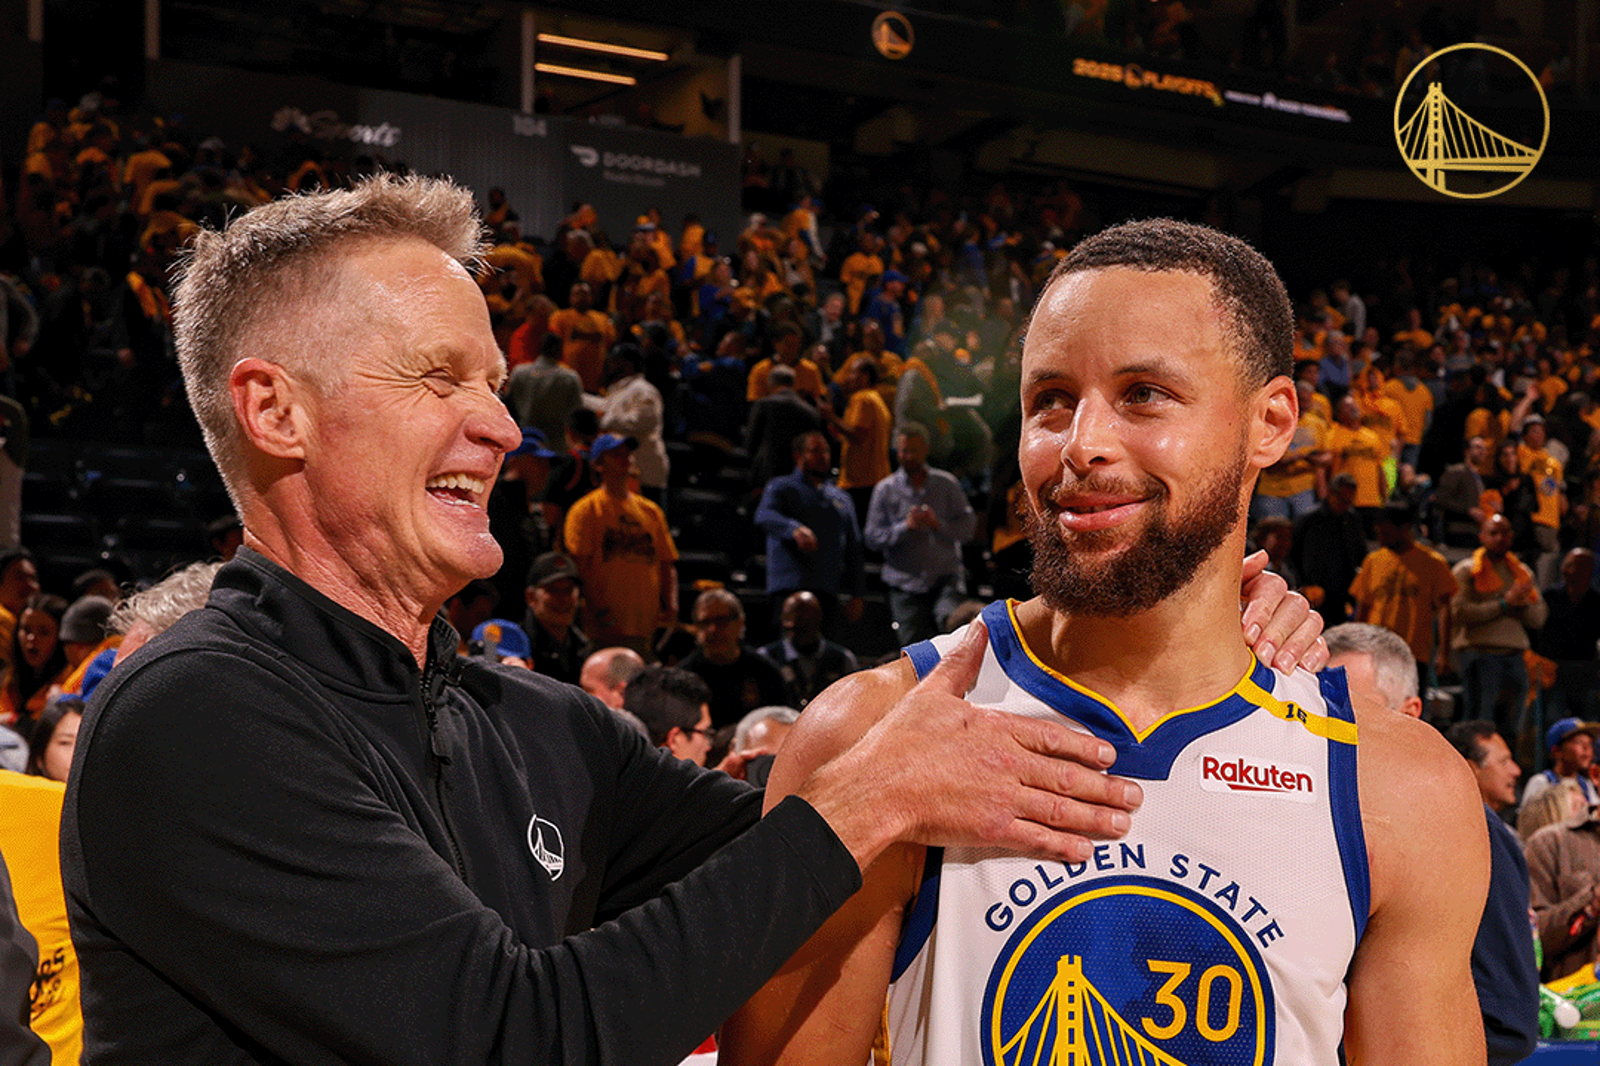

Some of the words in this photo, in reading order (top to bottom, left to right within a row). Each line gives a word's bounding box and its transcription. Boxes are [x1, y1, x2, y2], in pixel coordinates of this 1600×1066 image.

[1202, 756, 1313, 792] Rakuten
[985, 842, 1146, 931] GOLDEN
[1169, 853, 1285, 948] STATE
[1141, 958, 1244, 1042] 30
